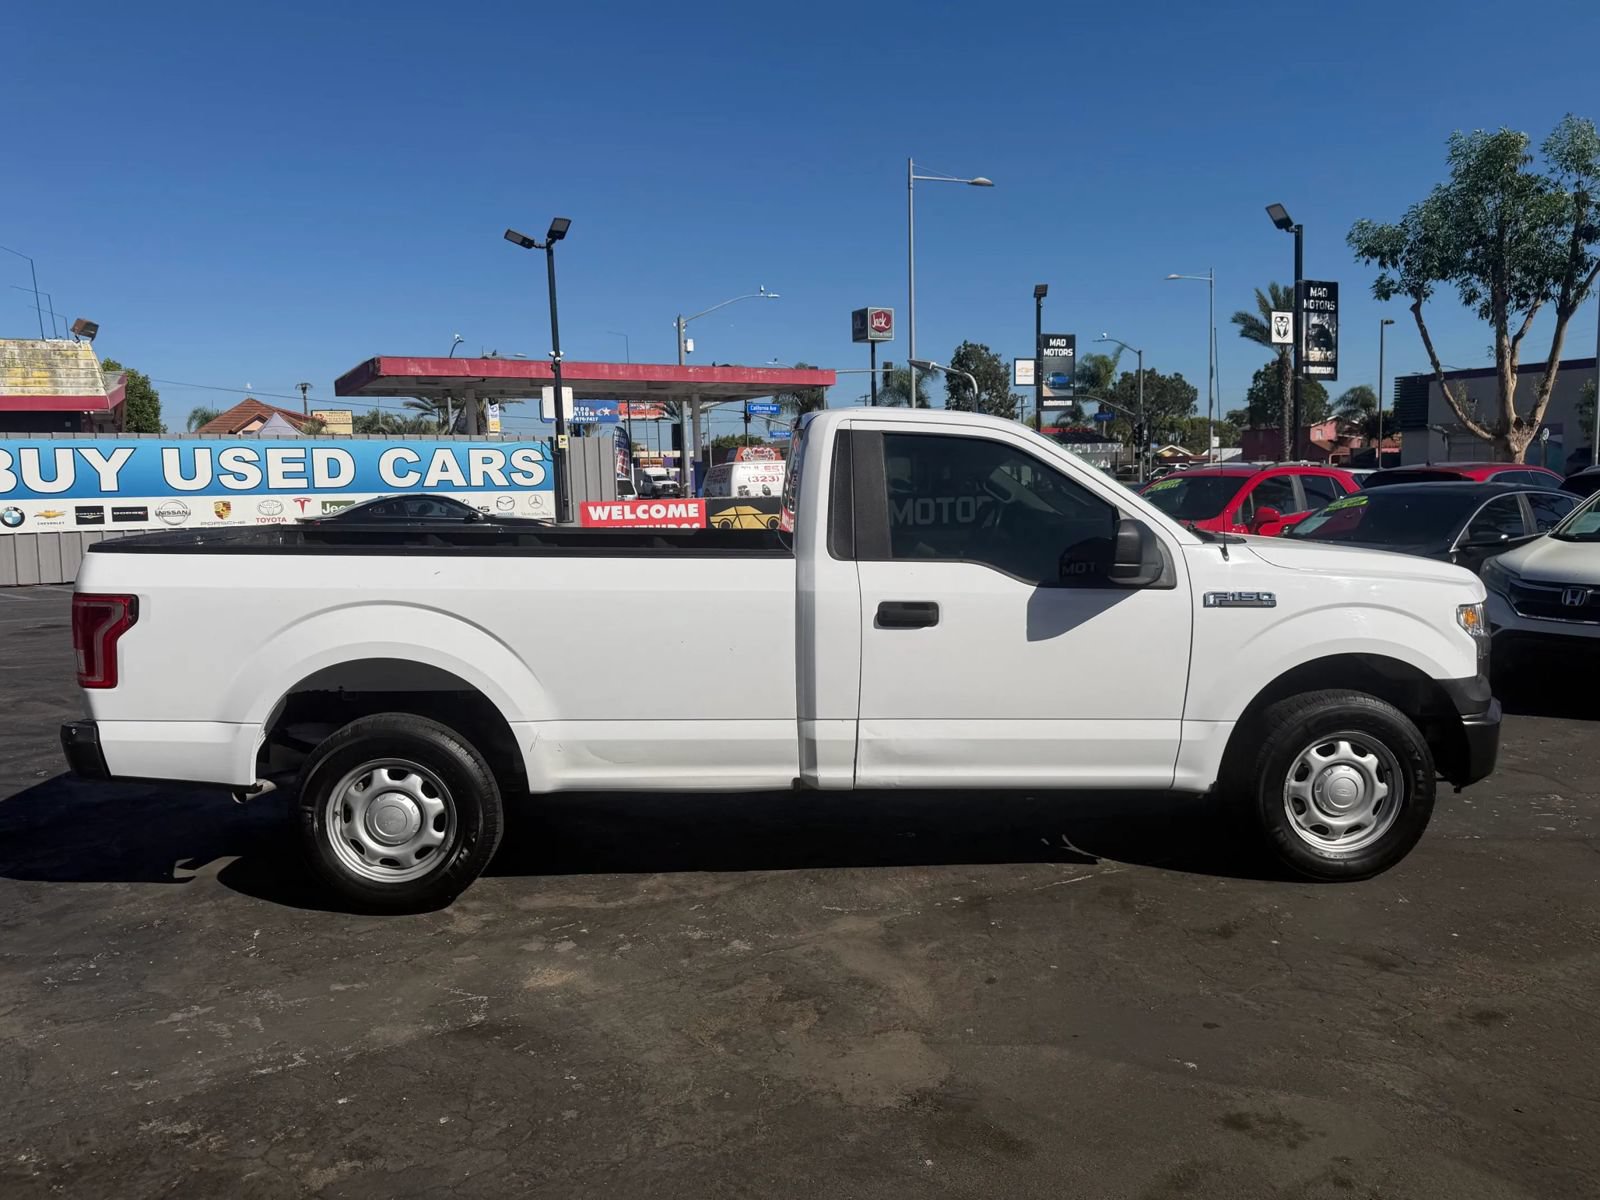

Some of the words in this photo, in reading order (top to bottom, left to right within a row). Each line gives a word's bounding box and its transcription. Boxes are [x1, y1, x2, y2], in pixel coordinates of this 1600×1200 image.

[1310, 286, 1328, 297] MAD
[1303, 298, 1336, 311] MOTORS
[1049, 338, 1067, 347] MAD
[1043, 348, 1073, 356] MOTORS
[160, 447, 357, 490] USED
[378, 447, 546, 488] CARS
[748, 475, 780, 483] (323)
[588, 503, 699, 520] WELCOME
